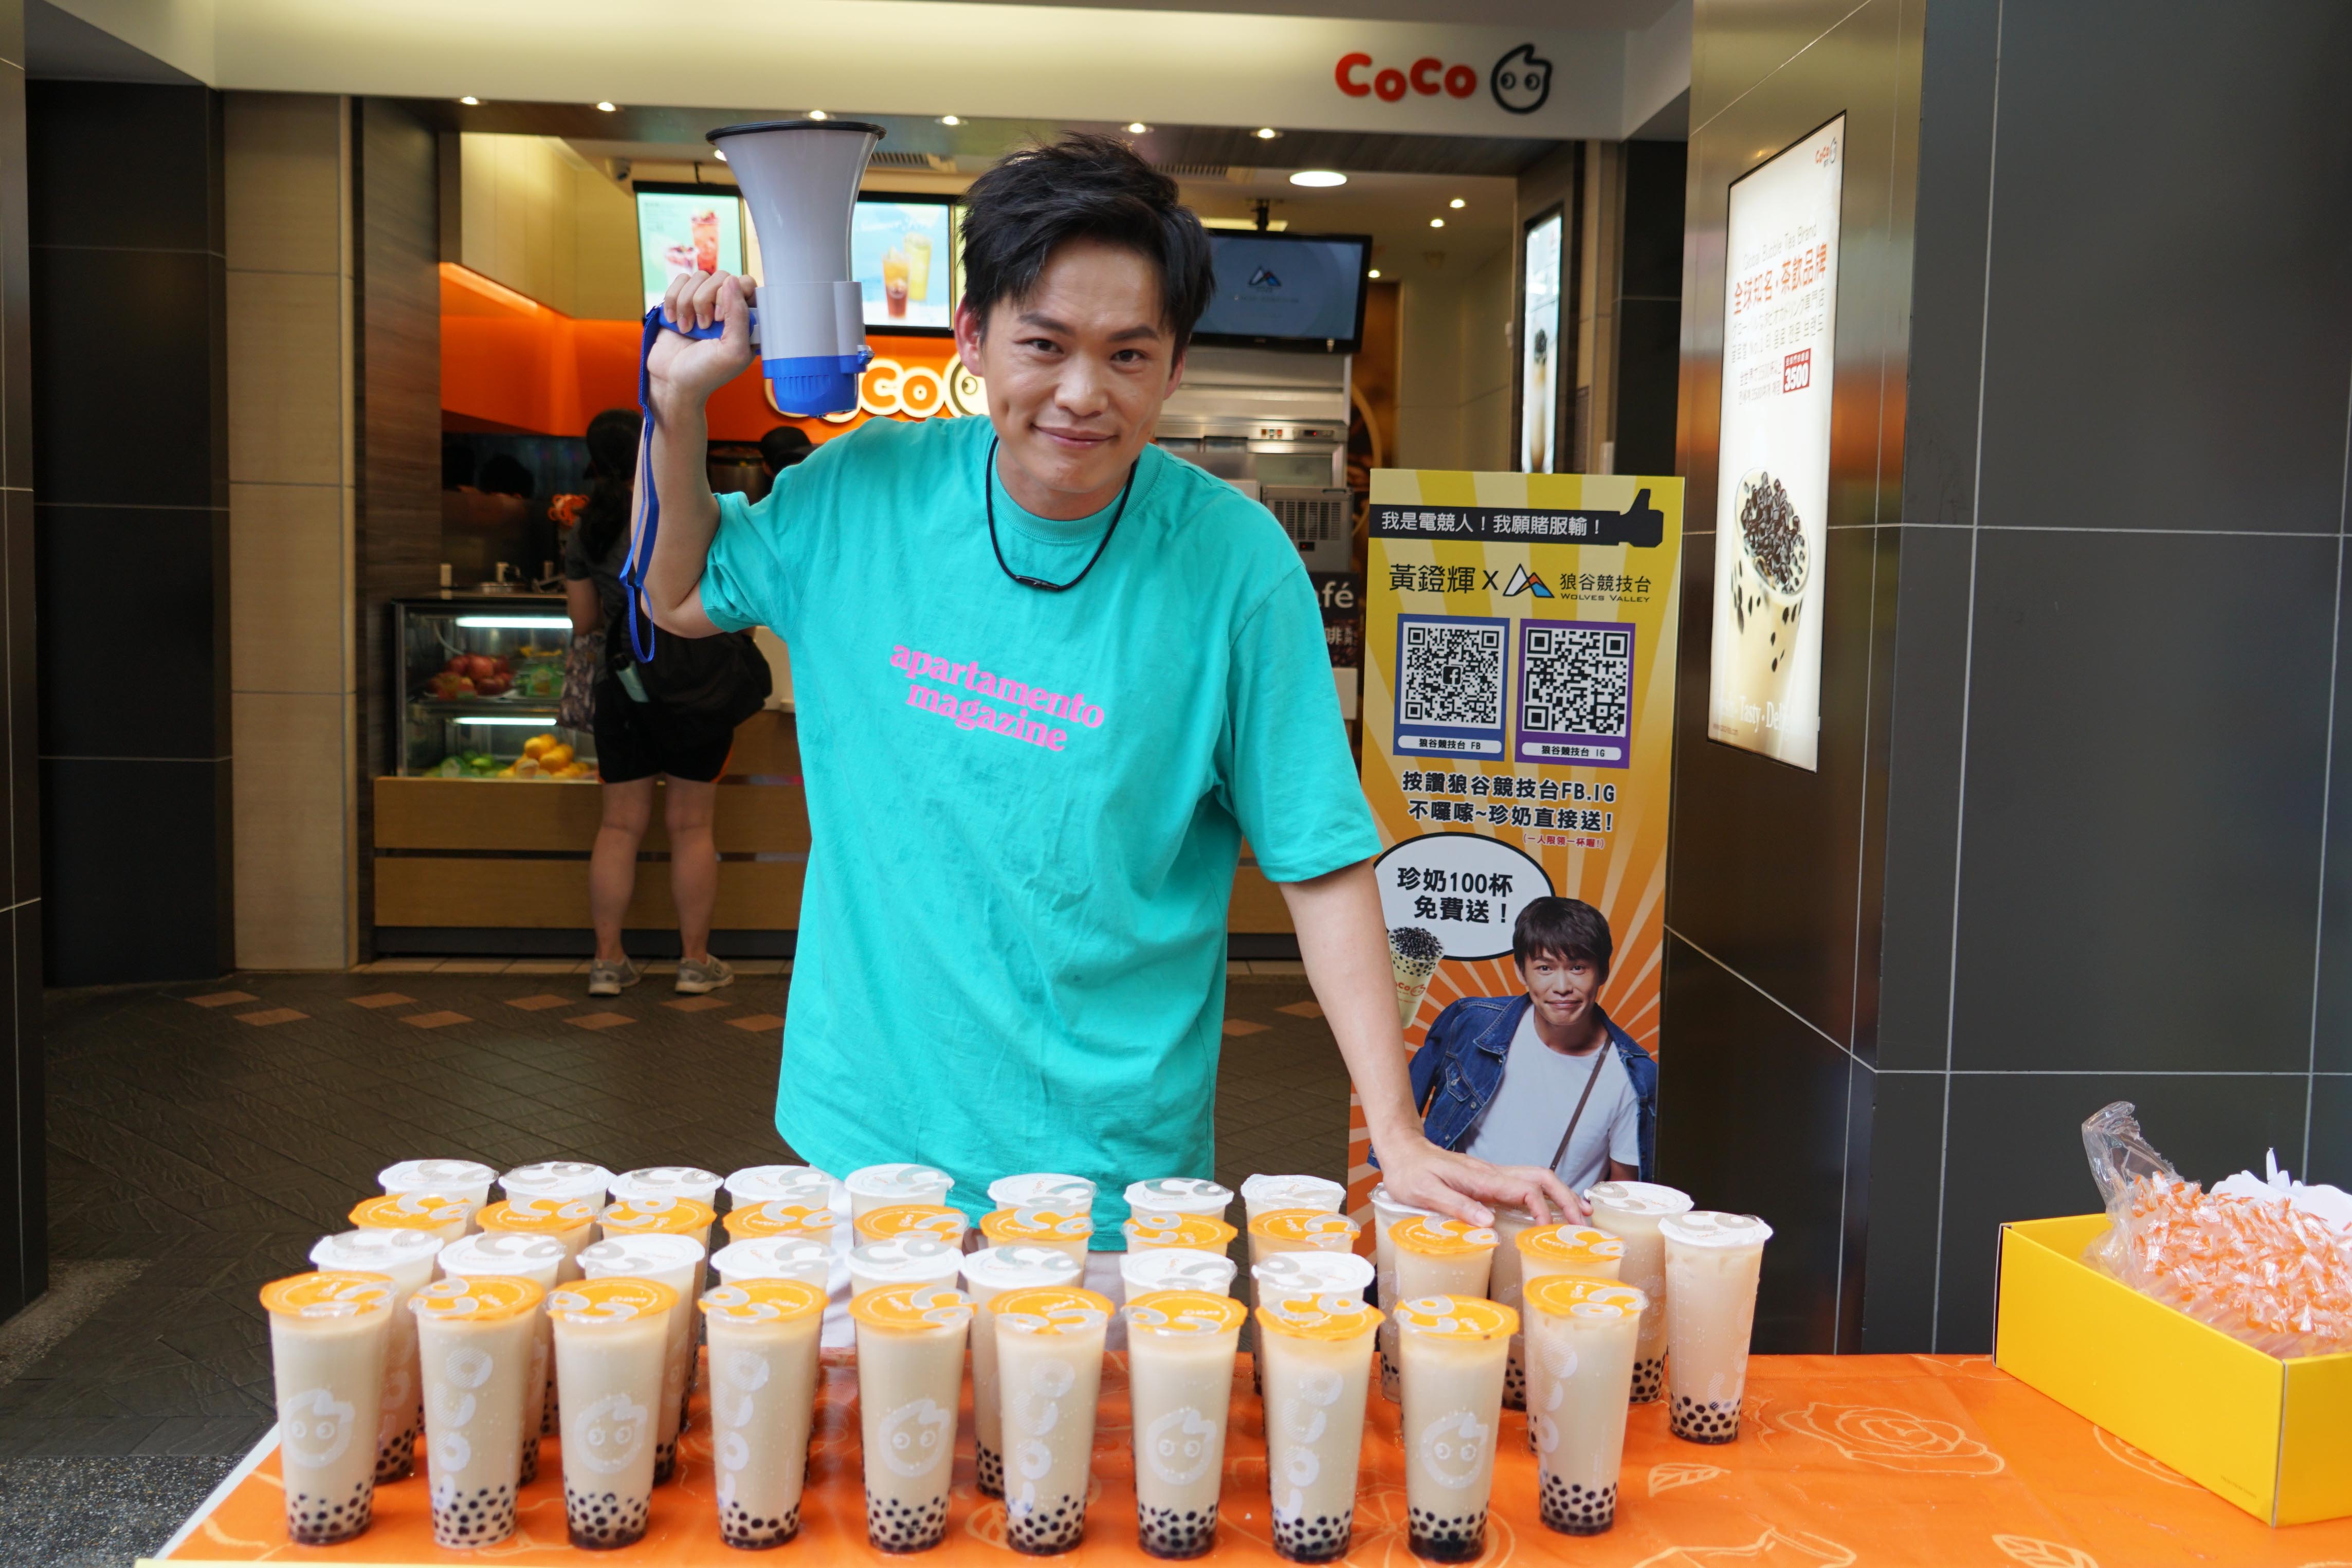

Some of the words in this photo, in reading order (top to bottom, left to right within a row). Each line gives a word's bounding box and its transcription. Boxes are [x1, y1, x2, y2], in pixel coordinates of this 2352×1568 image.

[1335, 52, 1476, 102] CoCo
[1784, 233, 1796, 249] Tea
[1797, 224, 1817, 245] Brand
[1784, 362, 1809, 391] 3500
[1559, 573, 1652, 593] 狼谷競技台
[1560, 593, 1605, 601] WOLVES
[1610, 595, 1650, 603] VALLEY
[890, 645, 1104, 728] apartamento
[906, 684, 1067, 751] magazine
[1740, 696, 1762, 734] Tasty
[1596, 749, 1605, 757] IG
[1397, 867, 1513, 898] 珍奶100杯
